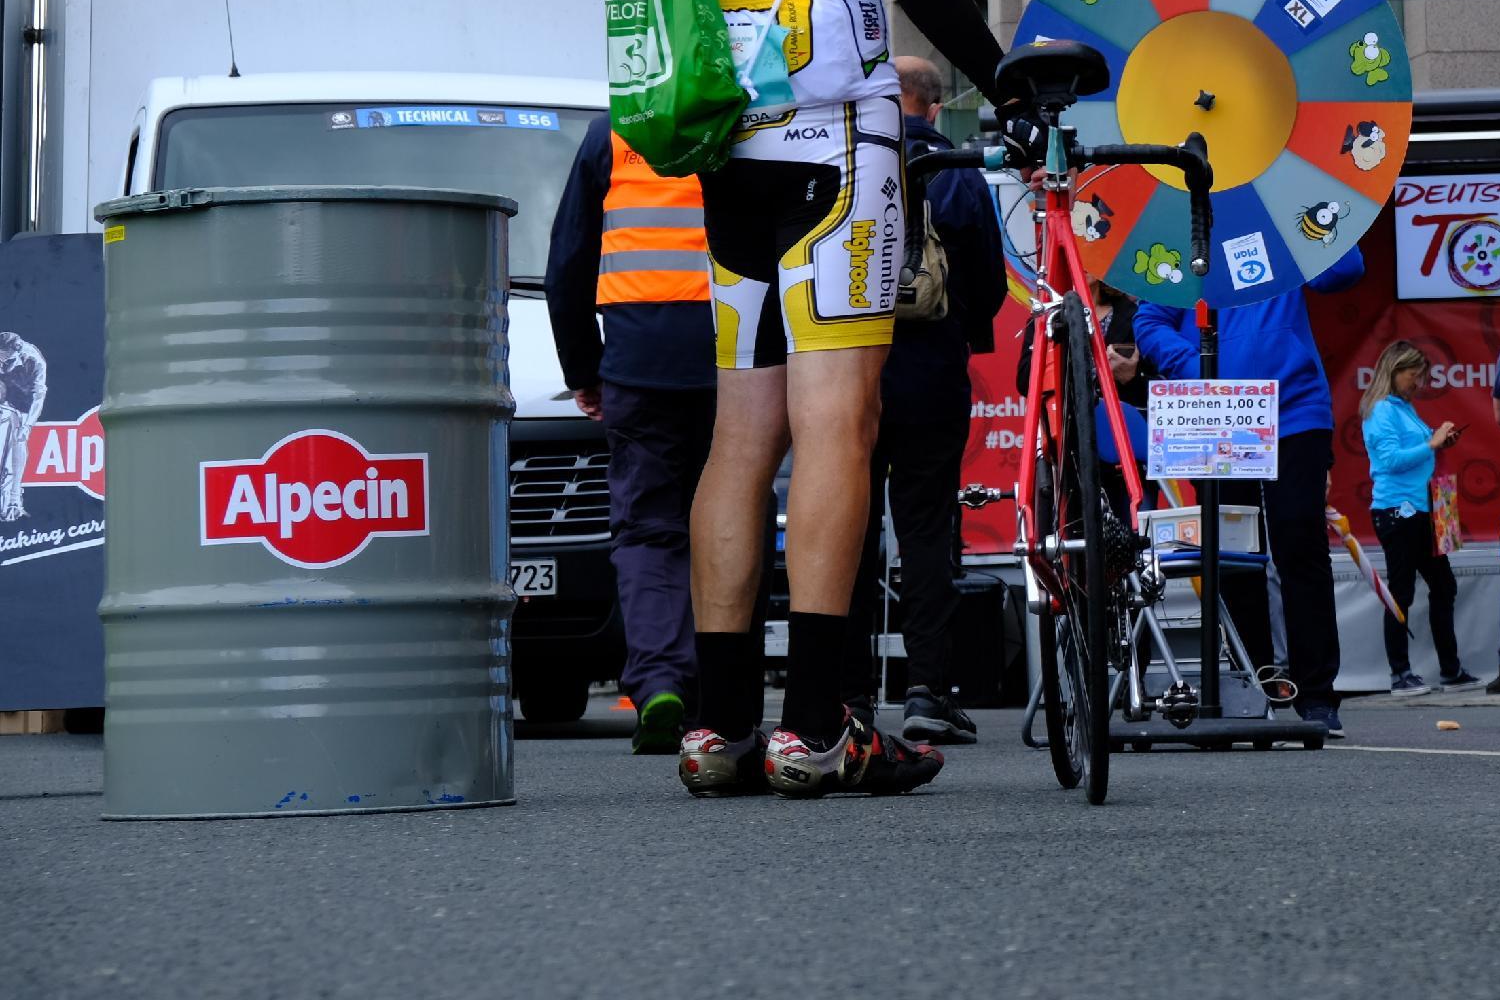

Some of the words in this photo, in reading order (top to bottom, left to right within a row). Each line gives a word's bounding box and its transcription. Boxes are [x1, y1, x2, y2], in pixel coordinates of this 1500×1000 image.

[1288, 0, 1314, 27] XL
[396, 109, 472, 123] TECHNICAL
[517, 114, 552, 127] 556
[783, 127, 830, 142] MOA
[842, 219, 877, 309] highroad
[879, 202, 899, 309] Columbia
[1150, 381, 1276, 396] Glücksrad
[1157, 400, 1163, 410] 1
[1167, 402, 1174, 410] x
[1177, 399, 1221, 409] Drehen
[1225, 398, 1254, 411] 1,00
[1258, 398, 1267, 409] €
[1156, 415, 1163, 426] 6
[1167, 417, 1174, 426] x
[1177, 415, 1221, 426] Drehen
[1225, 415, 1253, 427] 5,00
[1257, 415, 1265, 426] €
[222, 467, 409, 539] Alpecin
[511, 564, 553, 591] 723
